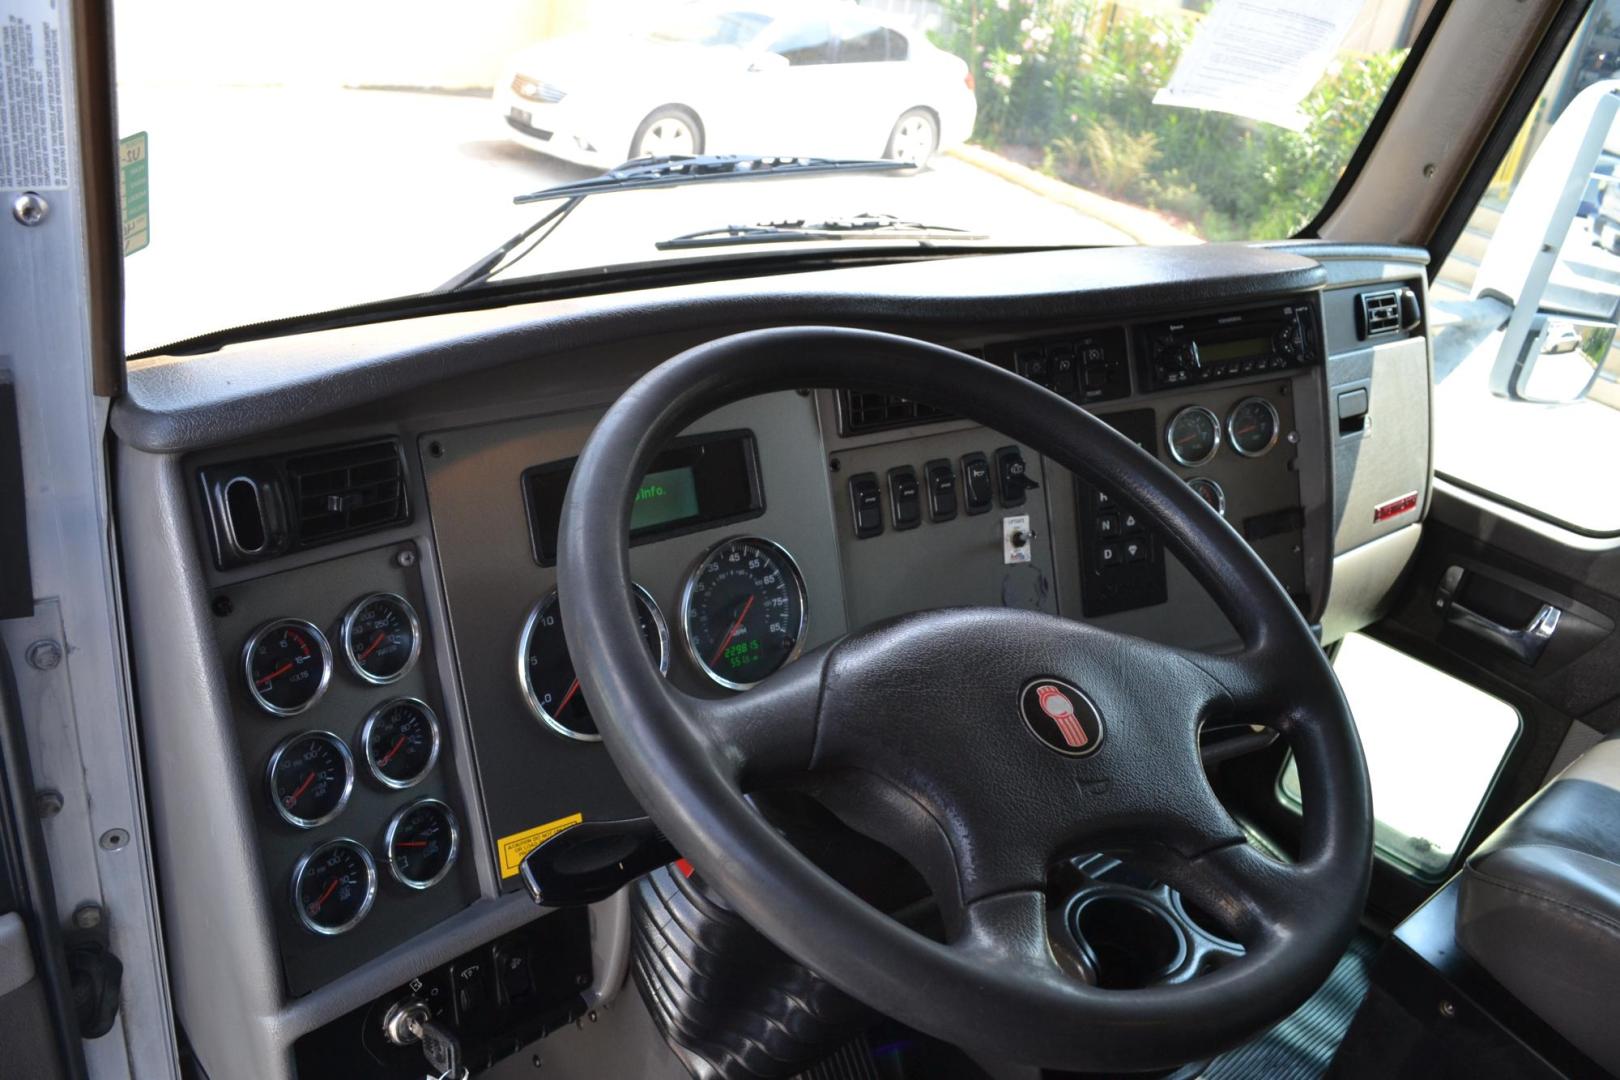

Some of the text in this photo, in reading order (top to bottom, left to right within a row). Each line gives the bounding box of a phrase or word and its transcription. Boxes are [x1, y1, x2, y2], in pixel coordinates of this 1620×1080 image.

[1102, 520, 1110, 530] N
[729, 553, 740, 562] 45
[1104, 549, 1112, 560] D
[748, 560, 760, 569] 55
[772, 598, 783, 607] 75
[540, 616, 554, 626] 10
[530, 656, 538, 665] 5
[544, 693, 552, 703] 0
